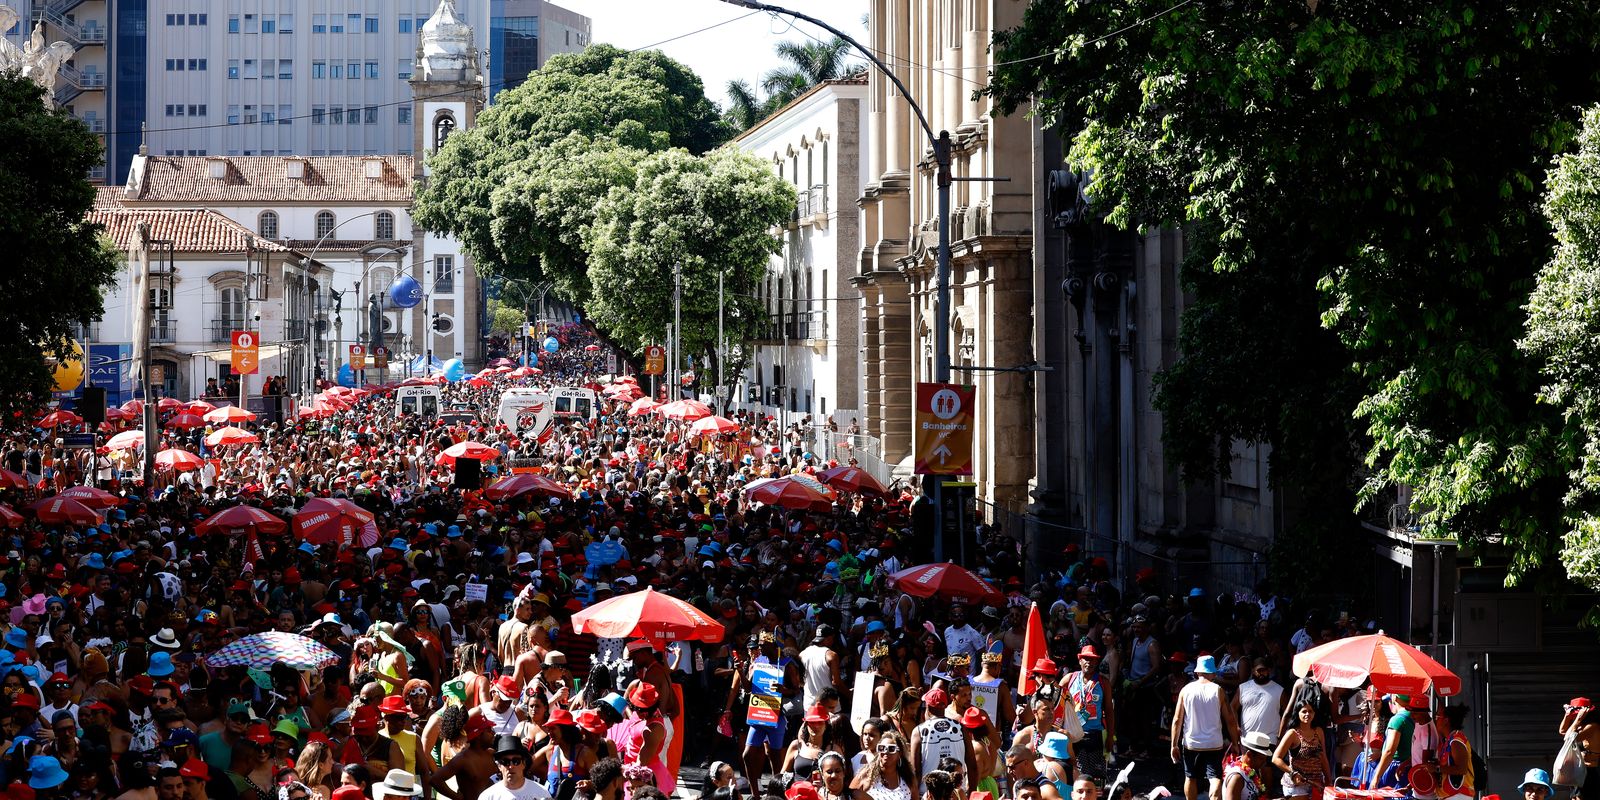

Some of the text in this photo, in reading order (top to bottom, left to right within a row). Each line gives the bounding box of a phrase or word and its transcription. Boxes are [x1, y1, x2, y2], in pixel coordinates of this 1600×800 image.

[922, 422, 966, 431] Banheiros
[301, 512, 330, 529] BRAHMA
[917, 566, 945, 584] BRAHMA
[976, 686, 997, 695] TADALA
